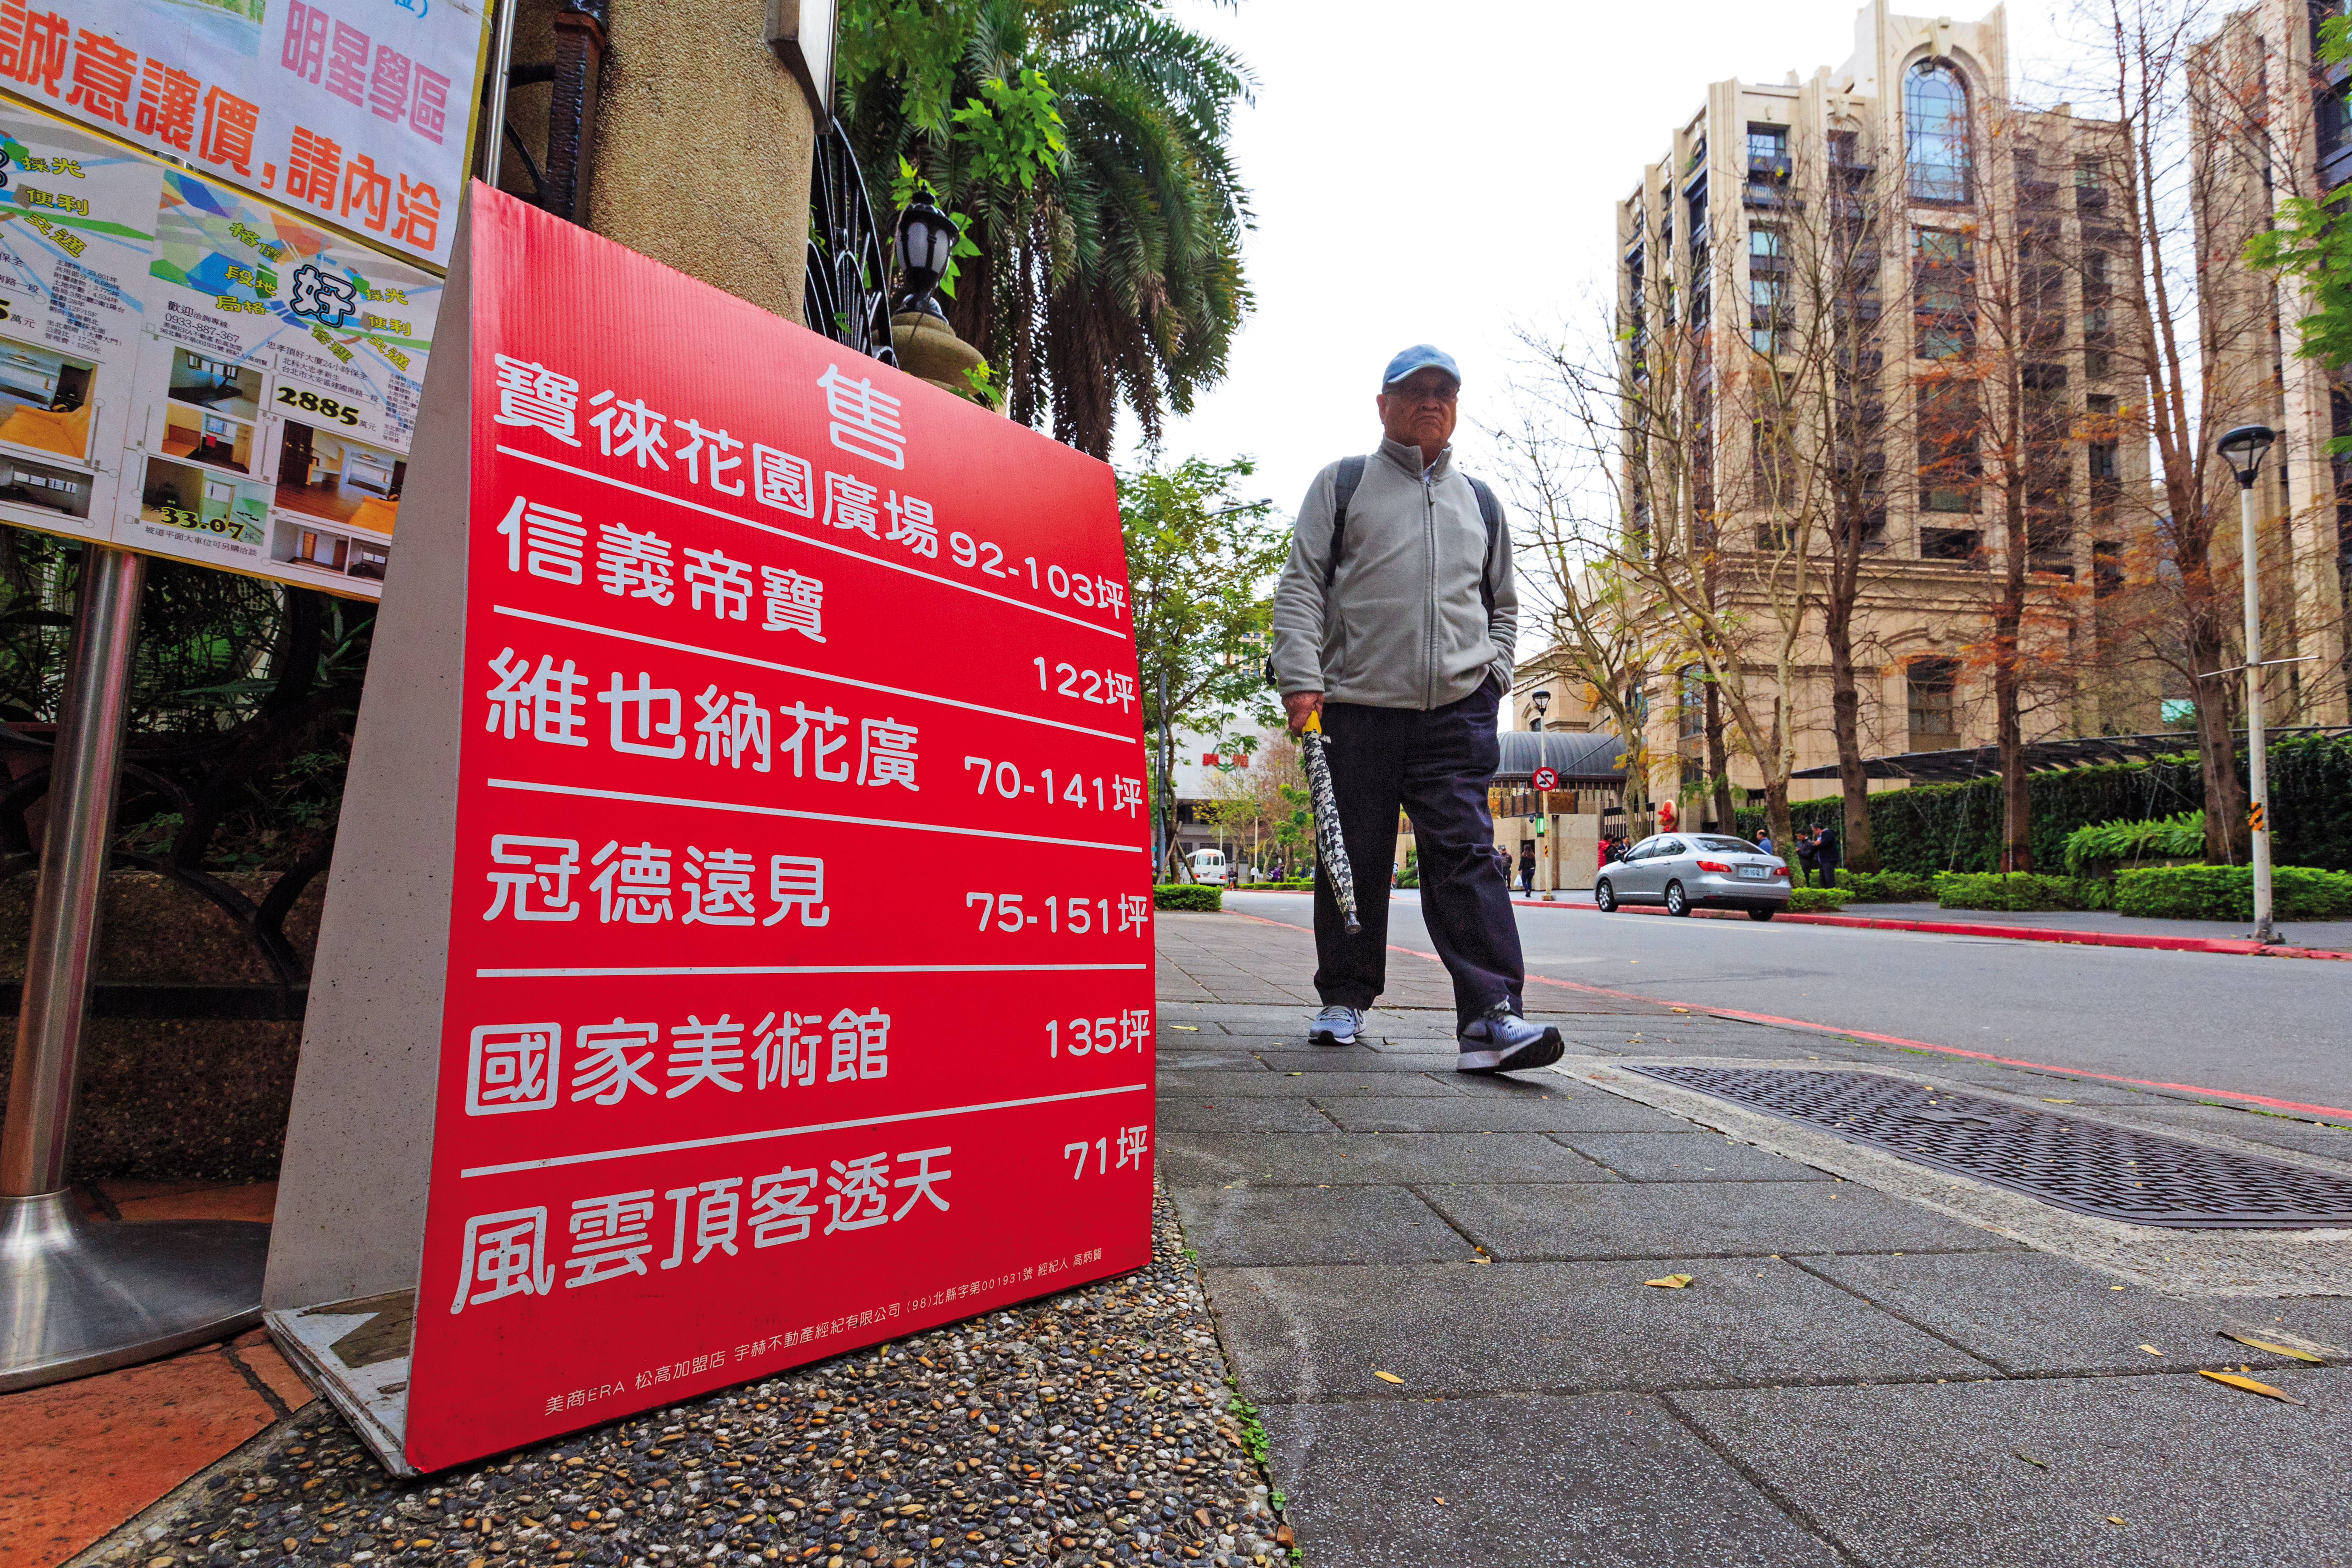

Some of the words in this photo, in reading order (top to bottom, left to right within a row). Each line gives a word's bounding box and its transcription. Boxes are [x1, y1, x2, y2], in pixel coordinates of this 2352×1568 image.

[281, 0, 451, 145] 明星學區
[20, 156, 86, 178] 採光
[26, 189, 89, 216] 便利
[24, 213, 87, 258] 交通
[166, 313, 240, 343] 0933-887-367
[290, 264, 357, 328] 好
[363, 288, 408, 305] 採光
[368, 315, 411, 336] 便利
[311, 325, 354, 364] 管理
[367, 335, 411, 371] 交通
[816, 363, 905, 470] 售
[494, 353, 939, 560] 寶徠花園廣場
[496, 495, 826, 644] 信義帝寶
[1033, 656, 1136, 714] 122坪
[486, 646, 919, 792] 維也納花廣
[482, 834, 830, 928] 冠德遠見
[464, 1006, 891, 1117] 國家美術館
[1046, 1008, 1151, 1059] 135坪
[450, 1145, 953, 1315] 風雲頂客透天
[1064, 1125, 1149, 1180] 71坪
[545, 1381, 625, 1416] 美商ERA
[634, 1351, 726, 1390] 松高加盟店
[734, 1302, 900, 1362] 宇赫不動產經紀有限公司
[1038, 1257, 1068, 1277] 經紀人
[1073, 1248, 1102, 1267] 高炳賢
